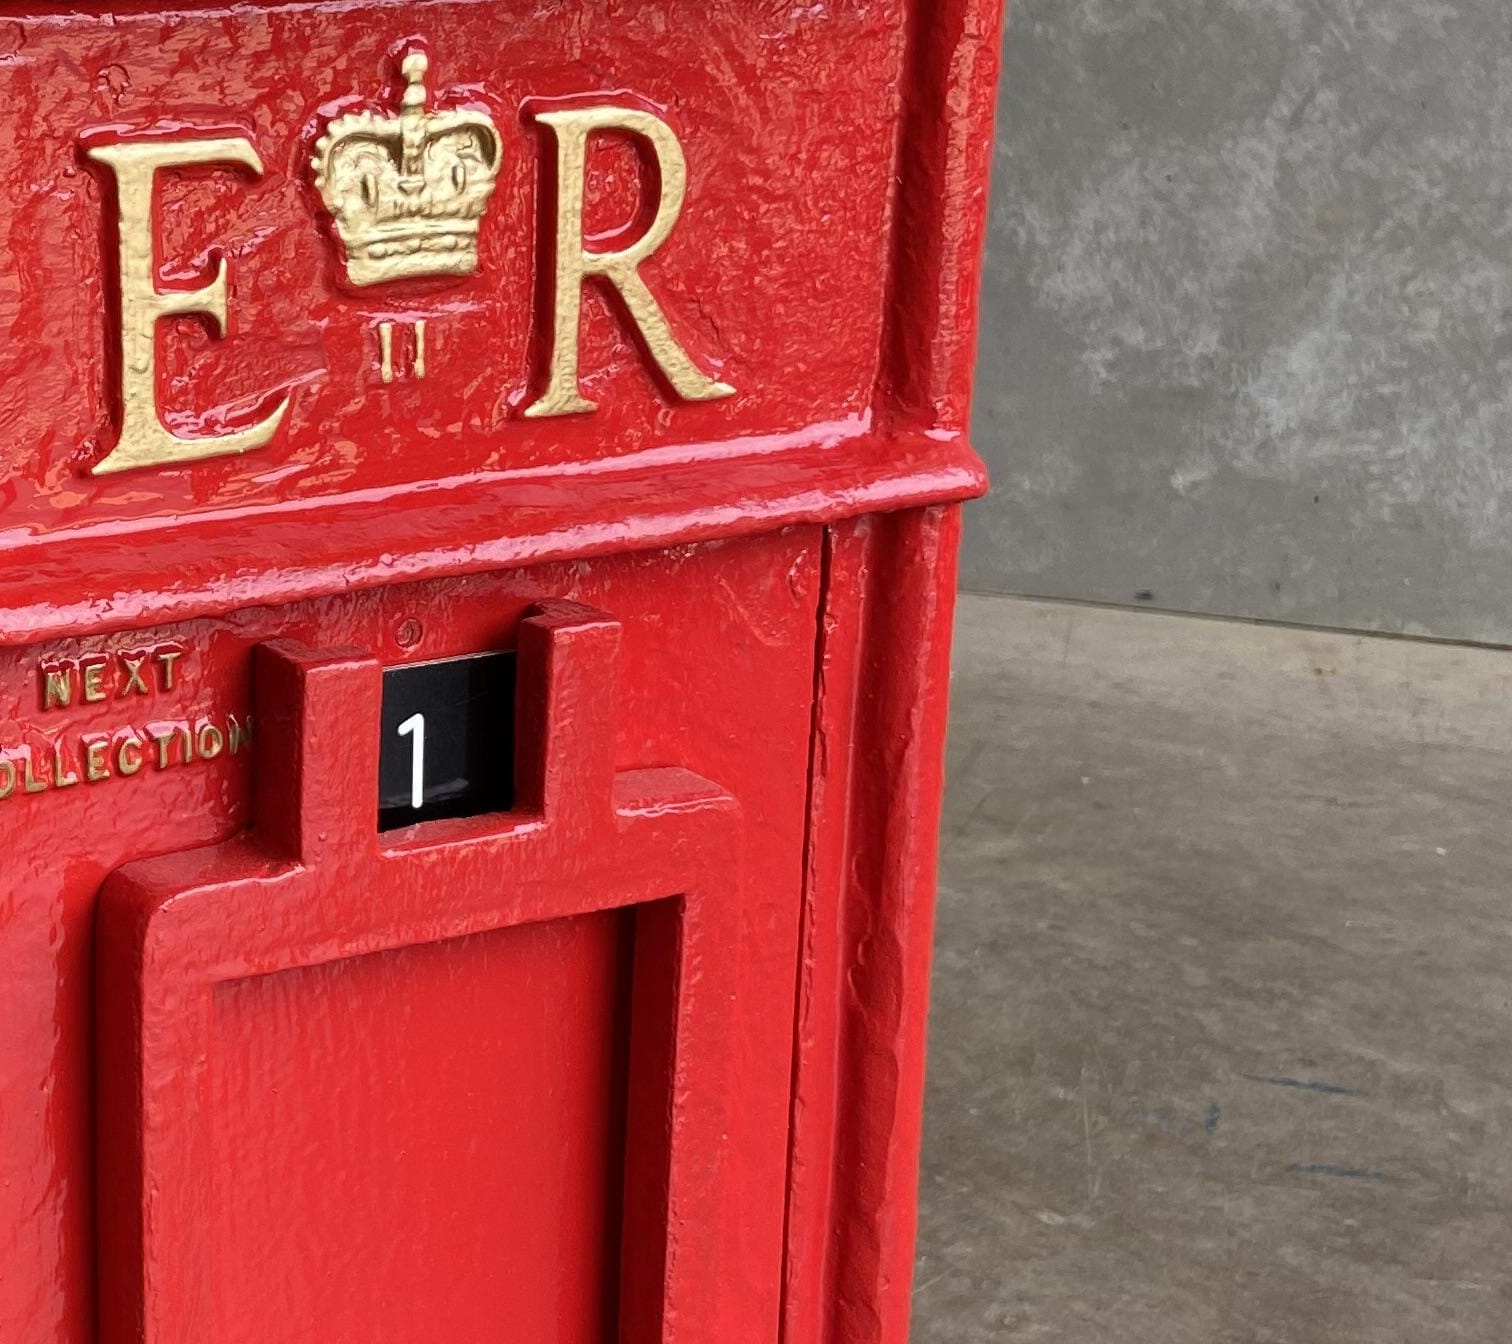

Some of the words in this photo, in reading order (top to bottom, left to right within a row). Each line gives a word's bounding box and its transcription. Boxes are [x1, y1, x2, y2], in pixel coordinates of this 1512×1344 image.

[88, 136, 289, 475] E
[524, 105, 737, 418] R
[43, 652, 182, 710] NEXT
[397, 712, 425, 809] 1
